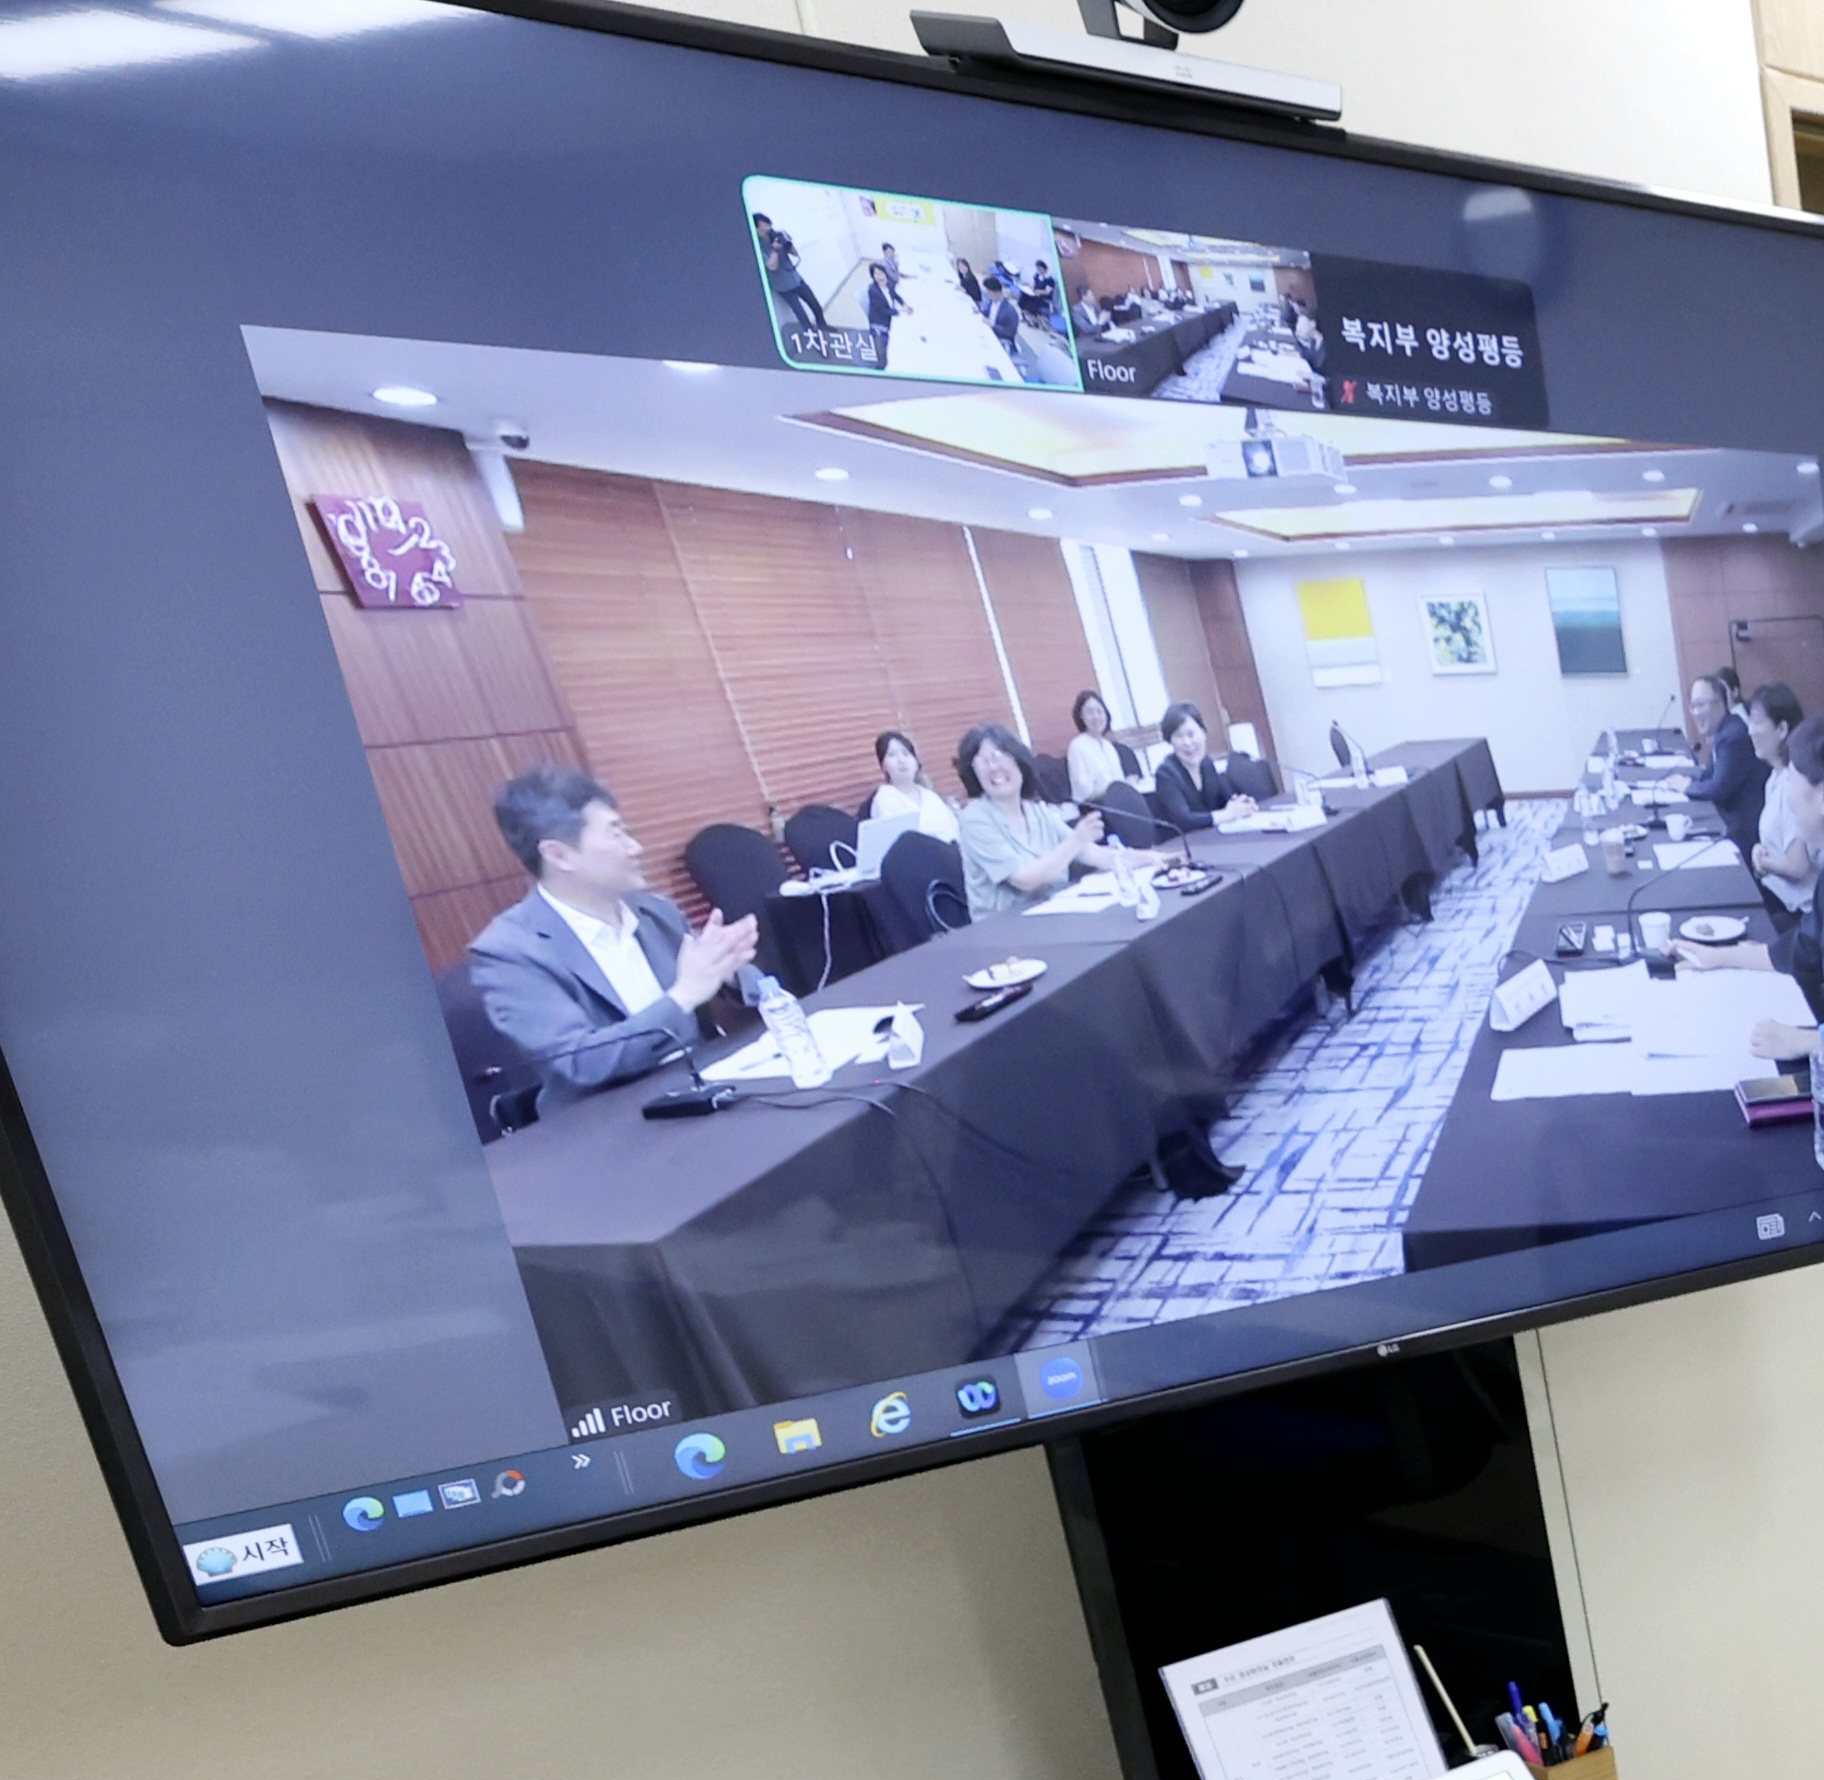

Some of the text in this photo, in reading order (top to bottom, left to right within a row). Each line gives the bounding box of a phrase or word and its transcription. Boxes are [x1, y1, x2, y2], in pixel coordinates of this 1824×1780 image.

[790, 328, 879, 362] 1차관실
[1341, 316, 1524, 369] 복지부 양성평등
[1087, 358, 1136, 384] Floor
[1366, 381, 1493, 416] 복지부 양성평등
[1047, 1371, 1078, 1386] zoom
[611, 1399, 672, 1428] Floor
[242, 1537, 290, 1564] 시작
